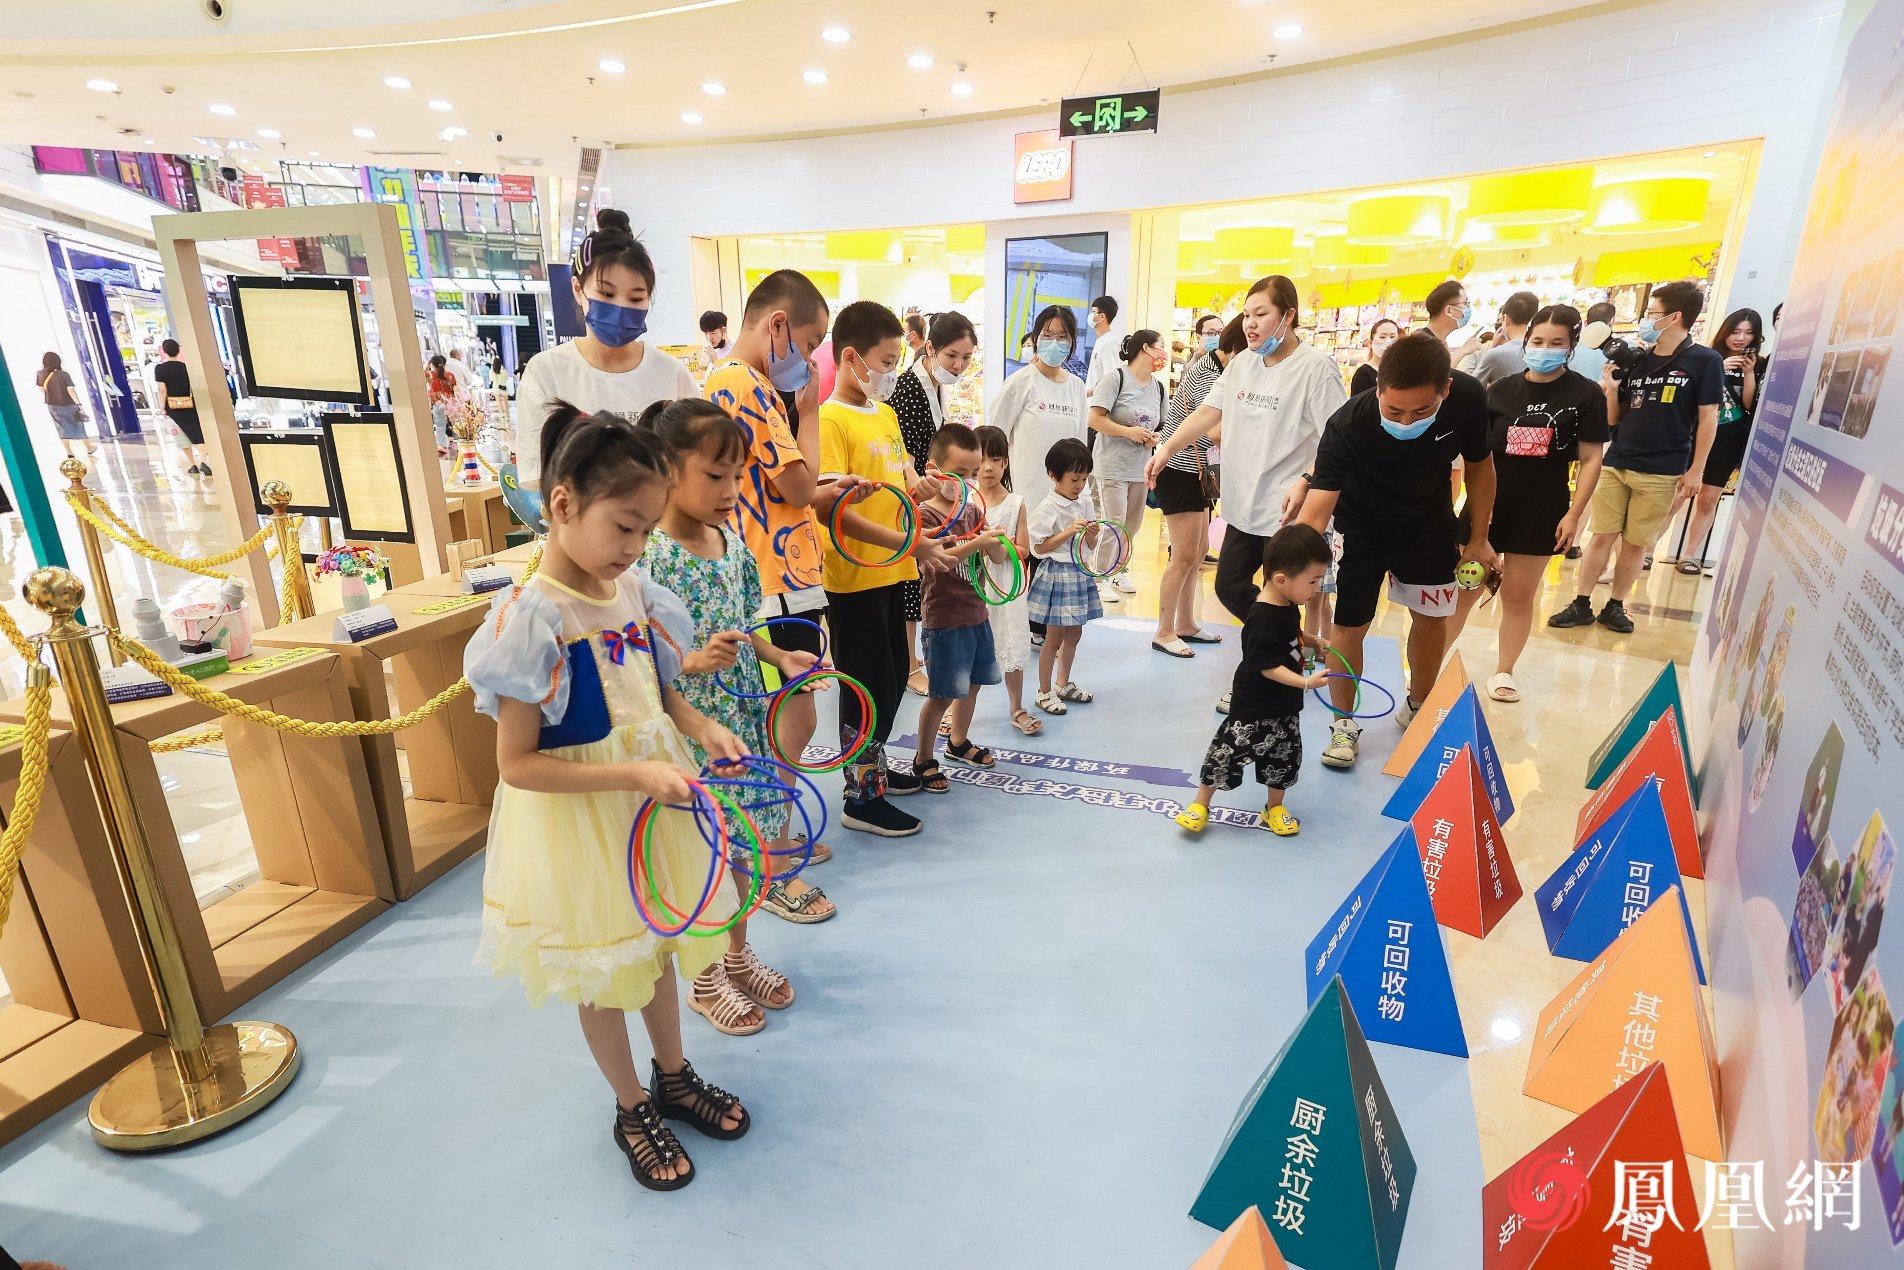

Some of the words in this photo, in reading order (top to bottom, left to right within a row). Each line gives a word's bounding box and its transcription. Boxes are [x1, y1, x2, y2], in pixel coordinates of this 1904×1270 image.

[1018, 149, 1069, 183] LEGO
[1482, 820, 1505, 900] 有害垃圾
[1619, 860, 1654, 937] 可回收
[1377, 919, 1413, 1022] 可回收物
[1272, 1096, 1327, 1236] 厨余垃圾
[1365, 1084, 1400, 1213] 厨余垃圾
